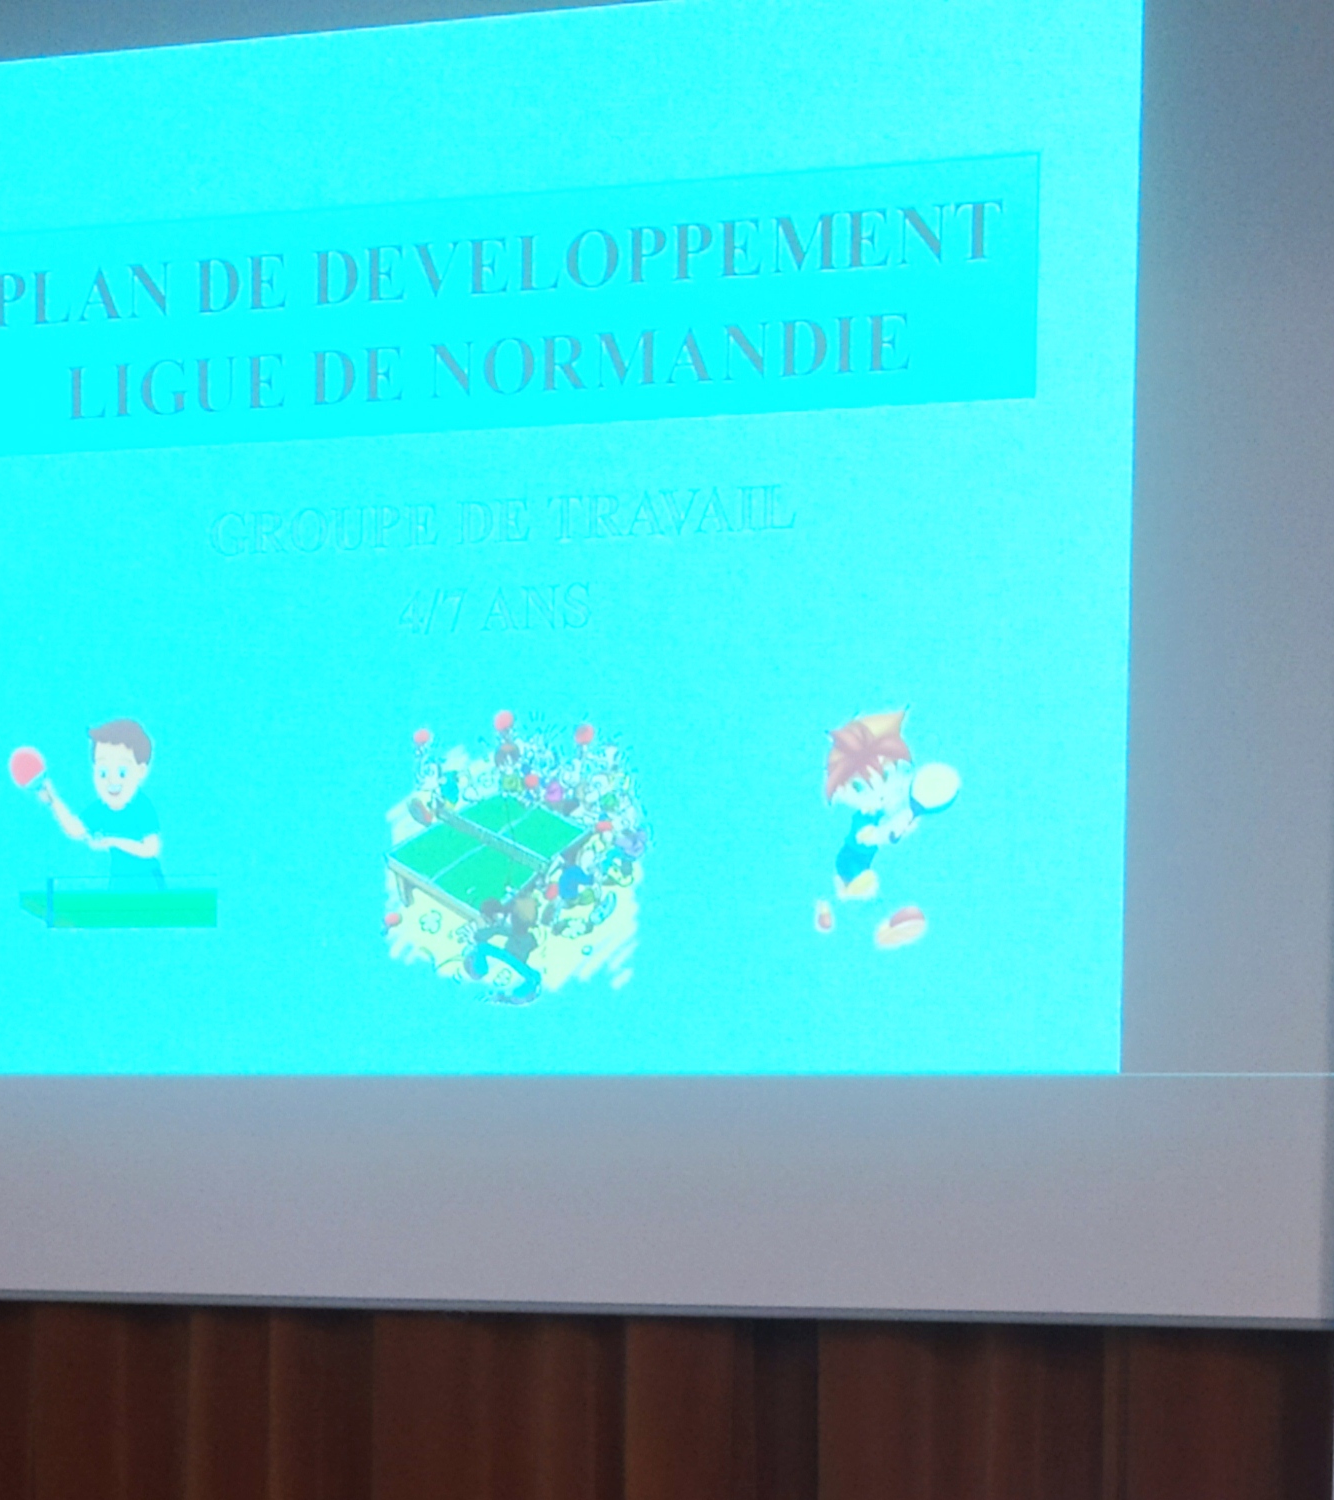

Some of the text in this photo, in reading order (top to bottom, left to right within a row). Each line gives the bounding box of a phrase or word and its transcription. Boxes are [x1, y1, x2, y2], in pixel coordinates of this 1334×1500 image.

[198, 250, 287, 314] DE
[314, 199, 1005, 307] DEVELOPPEMENT
[68, 311, 911, 422] LIGUE DE NORMANDIE
[208, 483, 797, 557] GROUPE DE TRAVAIL
[398, 582, 592, 635] 4/7 ANS
